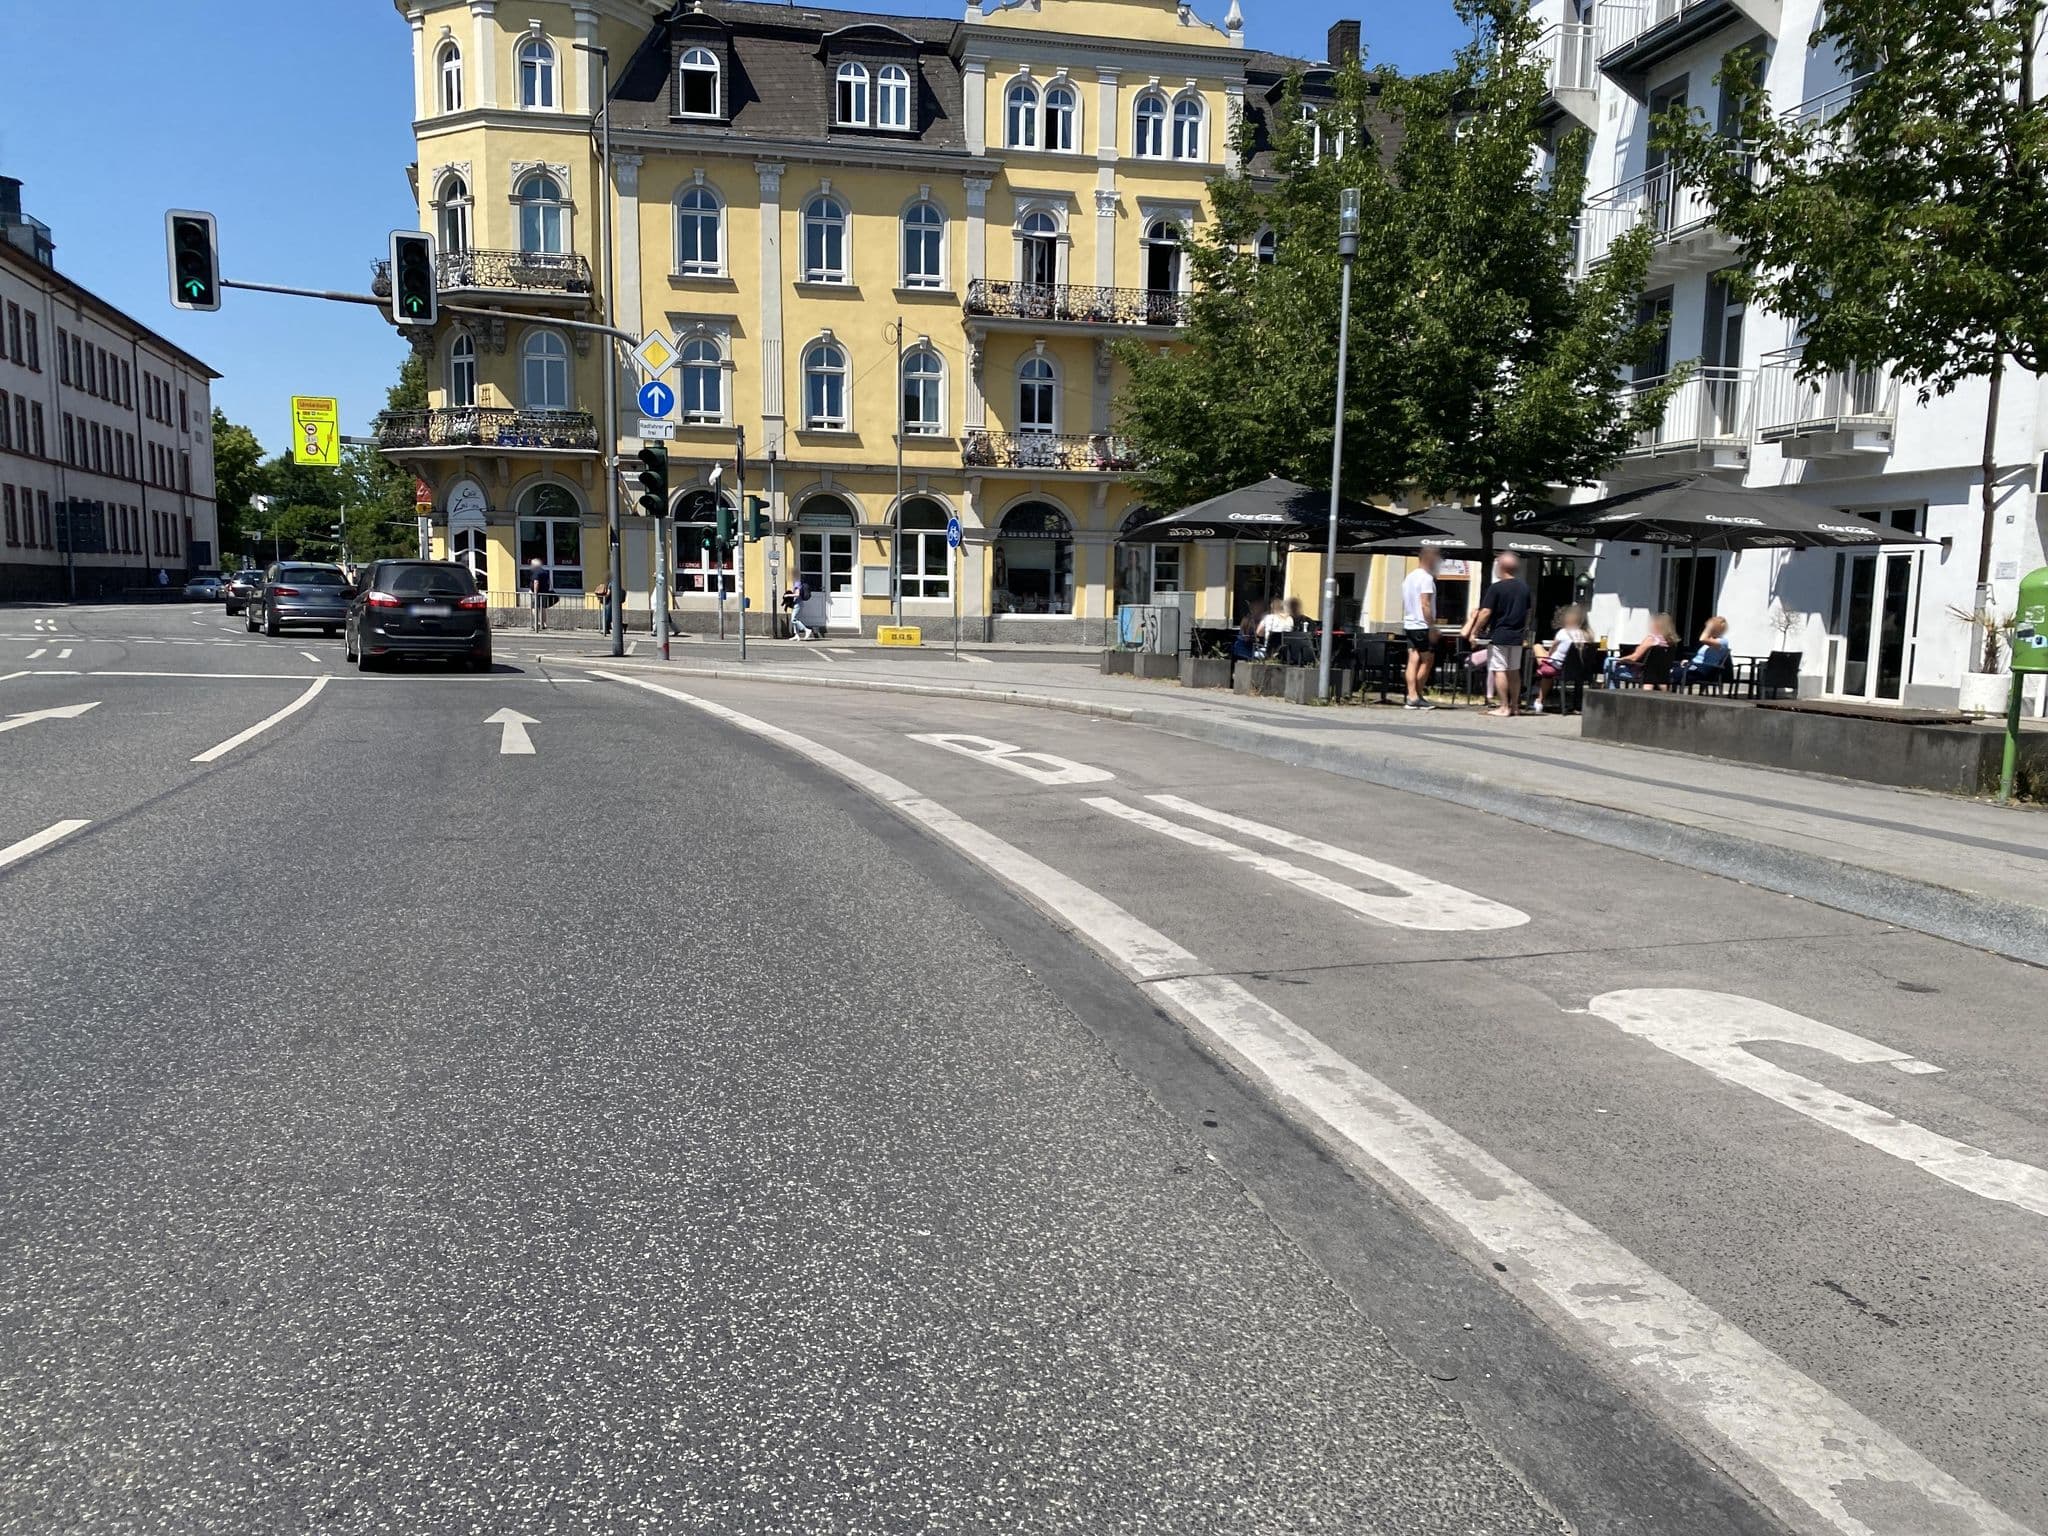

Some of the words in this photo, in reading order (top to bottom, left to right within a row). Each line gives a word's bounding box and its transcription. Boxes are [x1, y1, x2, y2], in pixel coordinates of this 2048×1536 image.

[1228, 512, 1286, 522] Coca-Cola
[1705, 514, 1767, 526] Coca-Cola
[1817, 523, 1879, 535] Coca-Cola
[1420, 538, 1468, 547] Coca-Cola
[1508, 542, 1555, 552] Coca-Cola
